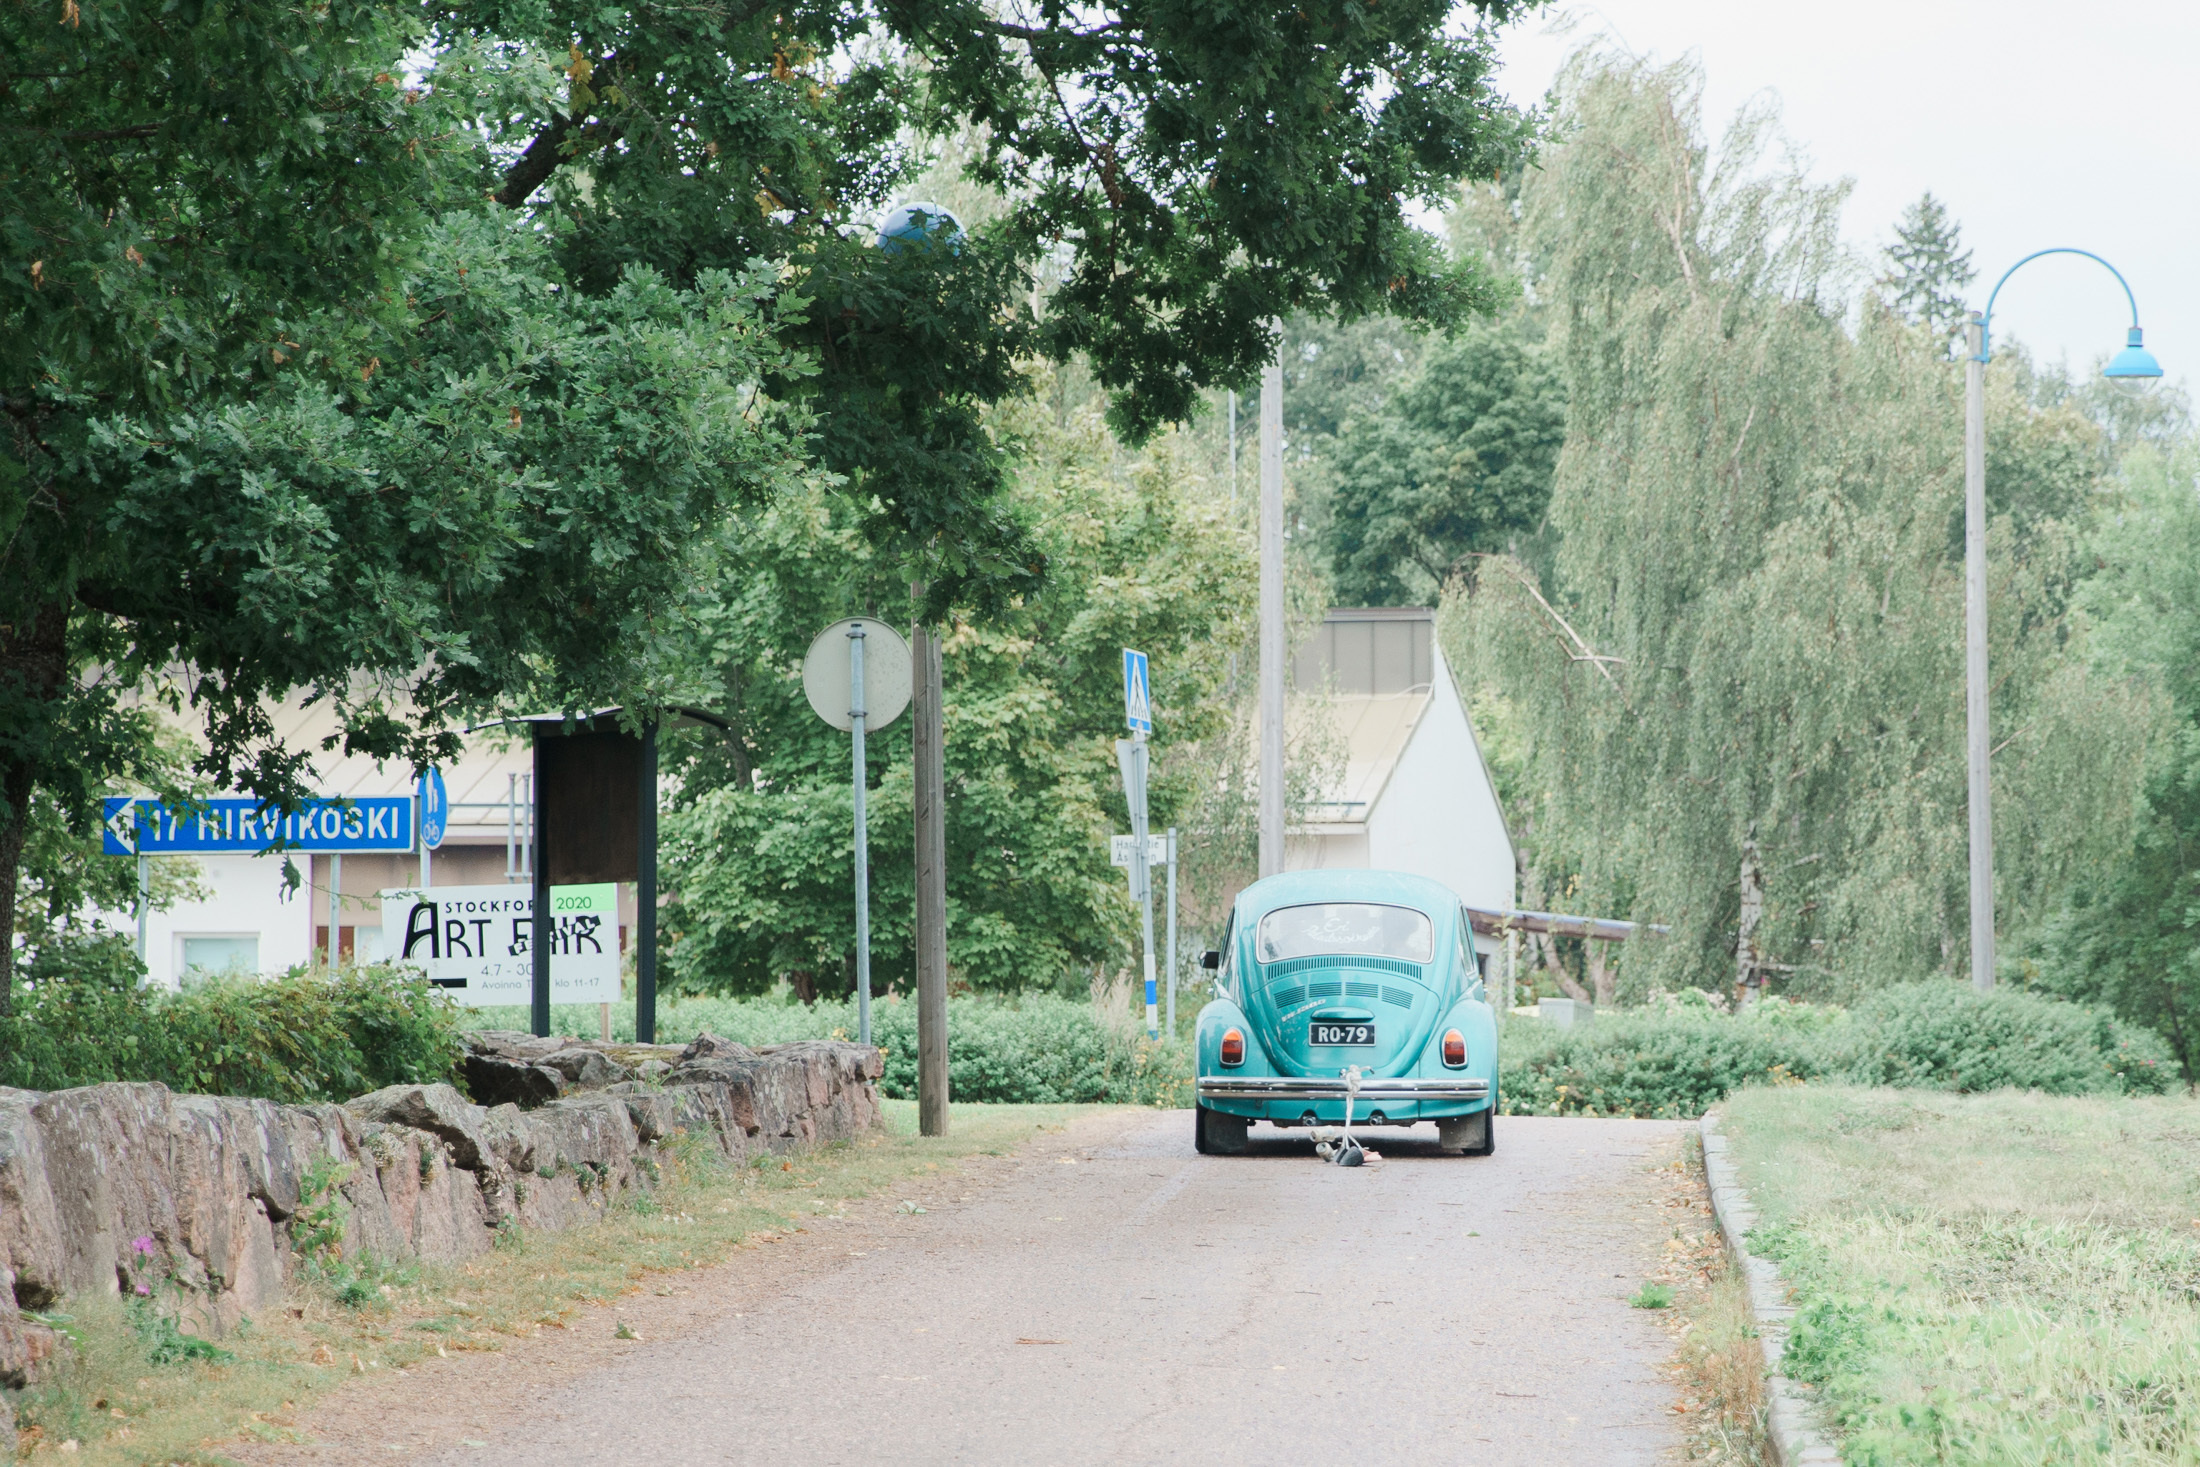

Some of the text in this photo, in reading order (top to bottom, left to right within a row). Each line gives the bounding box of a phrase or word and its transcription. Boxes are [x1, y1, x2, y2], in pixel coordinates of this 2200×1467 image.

[198, 807, 398, 840] HIRVIKOSKI
[445, 901, 534, 914] STOCKFOR
[556, 896, 592, 910] 2020
[401, 901, 602, 959] ART FIR
[481, 981, 522, 990] Avoinna
[555, 979, 570, 988] klo
[574, 977, 600, 988] 11-17
